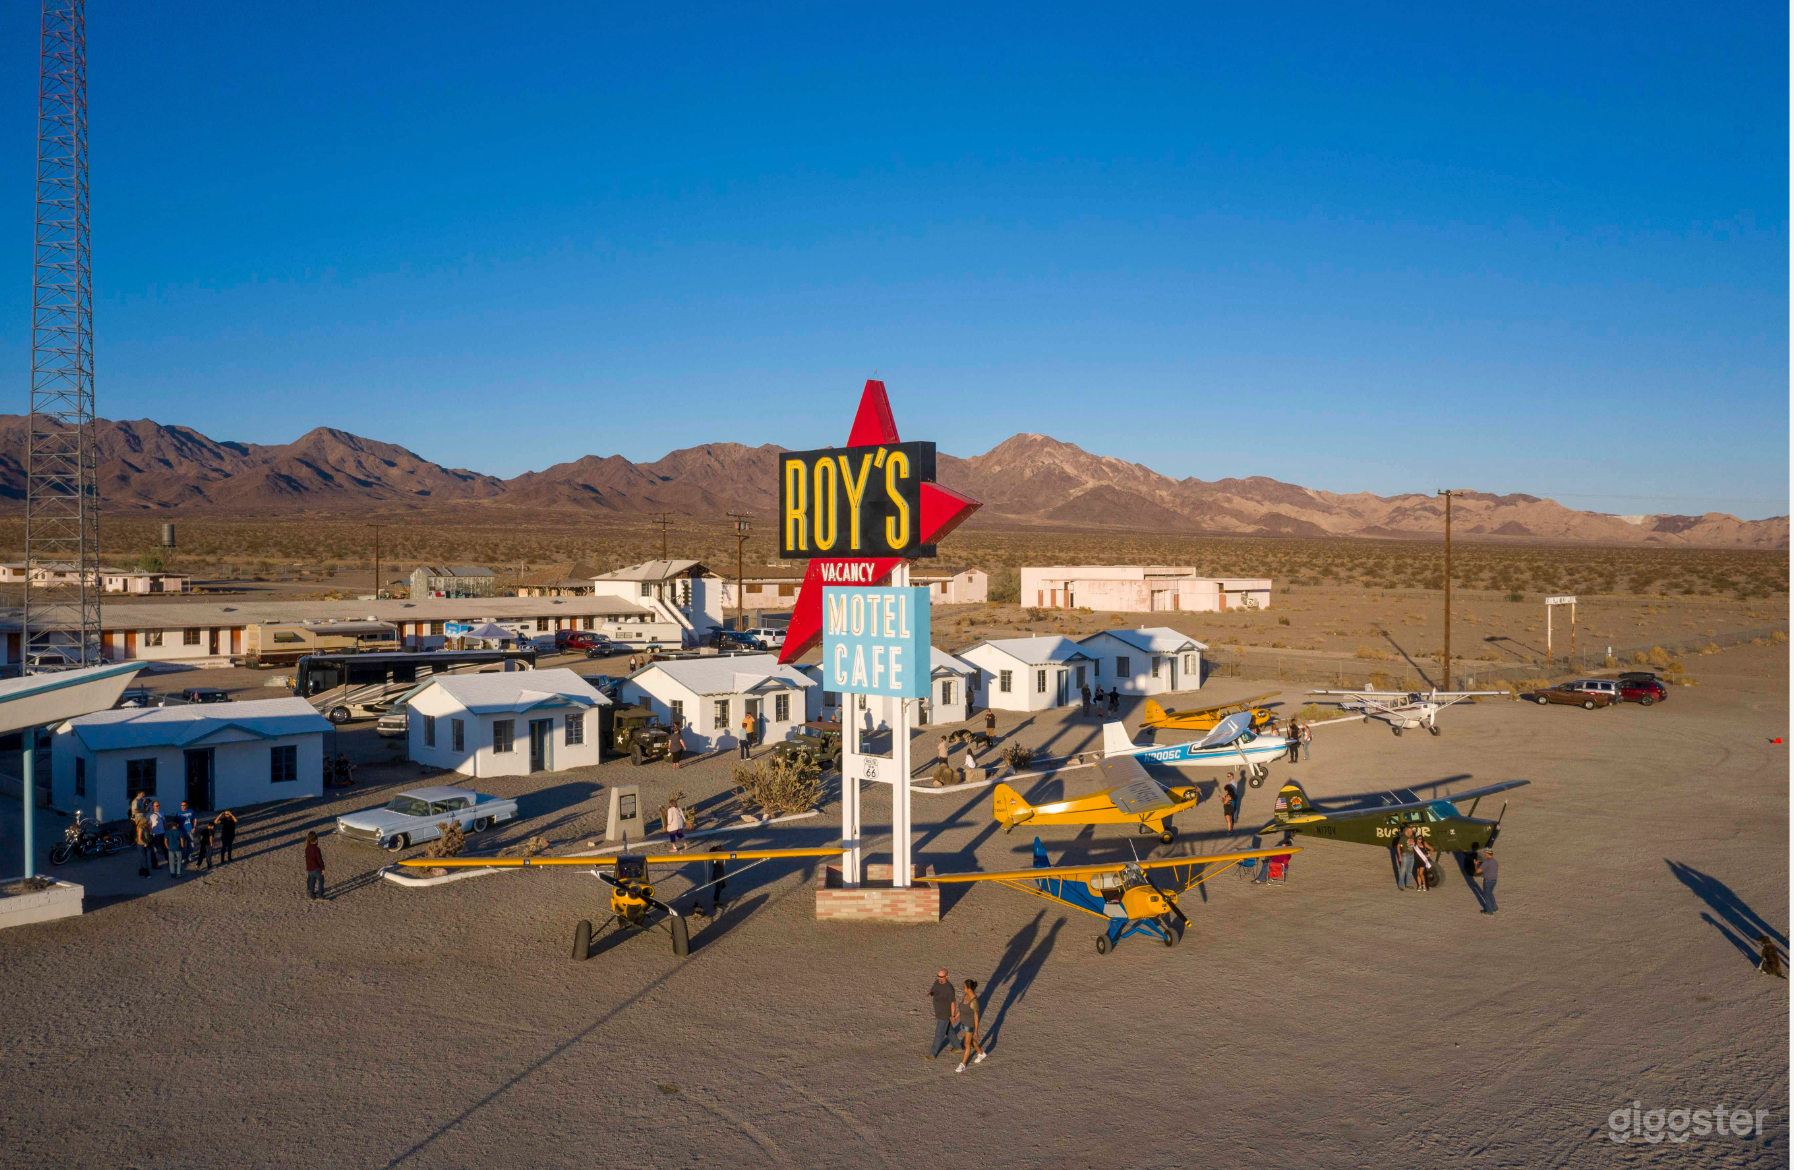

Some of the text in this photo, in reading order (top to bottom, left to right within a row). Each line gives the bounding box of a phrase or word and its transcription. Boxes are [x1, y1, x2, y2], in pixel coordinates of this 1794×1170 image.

[786, 447, 910, 551] ROY'S
[821, 563, 875, 582] VACANCY
[828, 593, 910, 639] MOTEL
[835, 643, 902, 689] CAFE
[866, 769, 876, 778] 66
